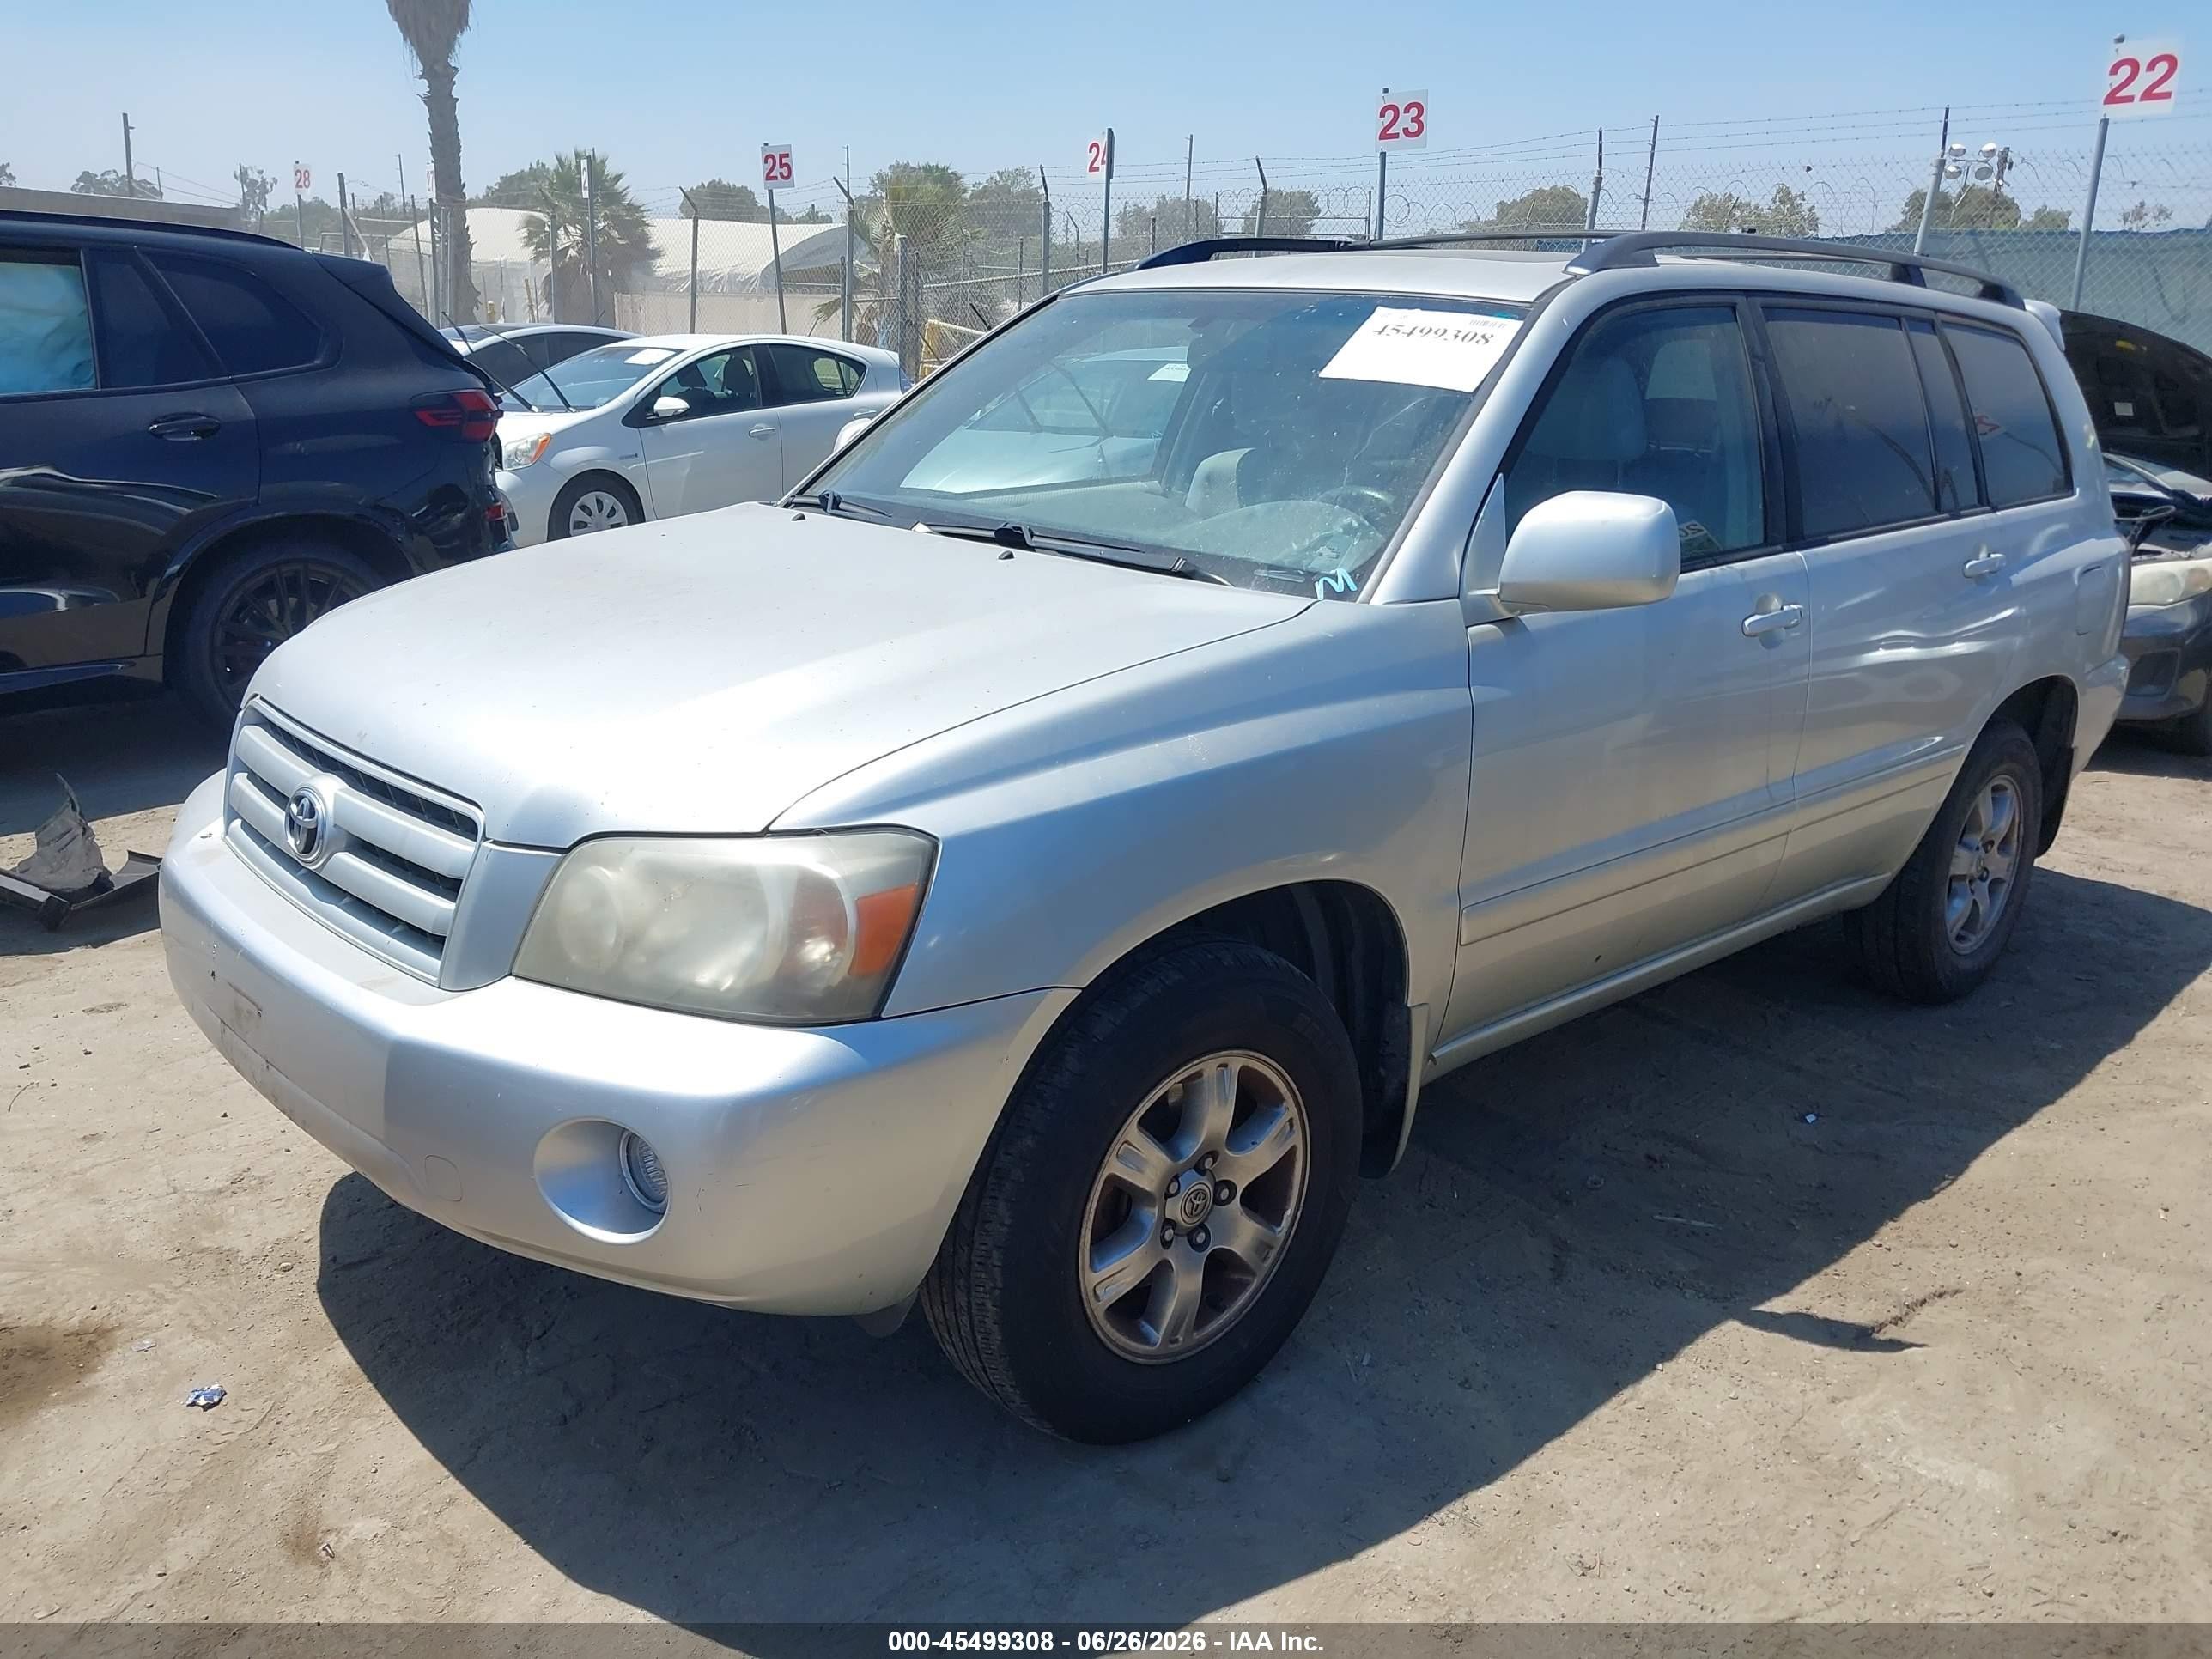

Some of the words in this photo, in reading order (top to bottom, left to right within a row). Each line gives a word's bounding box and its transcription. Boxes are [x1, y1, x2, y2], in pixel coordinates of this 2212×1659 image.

[2103, 54, 2178, 105] 22
[1379, 102, 1424, 140] 23
[295, 169, 310, 188] 28
[764, 153, 792, 180] 25
[1373, 325, 1494, 344] 45499308
